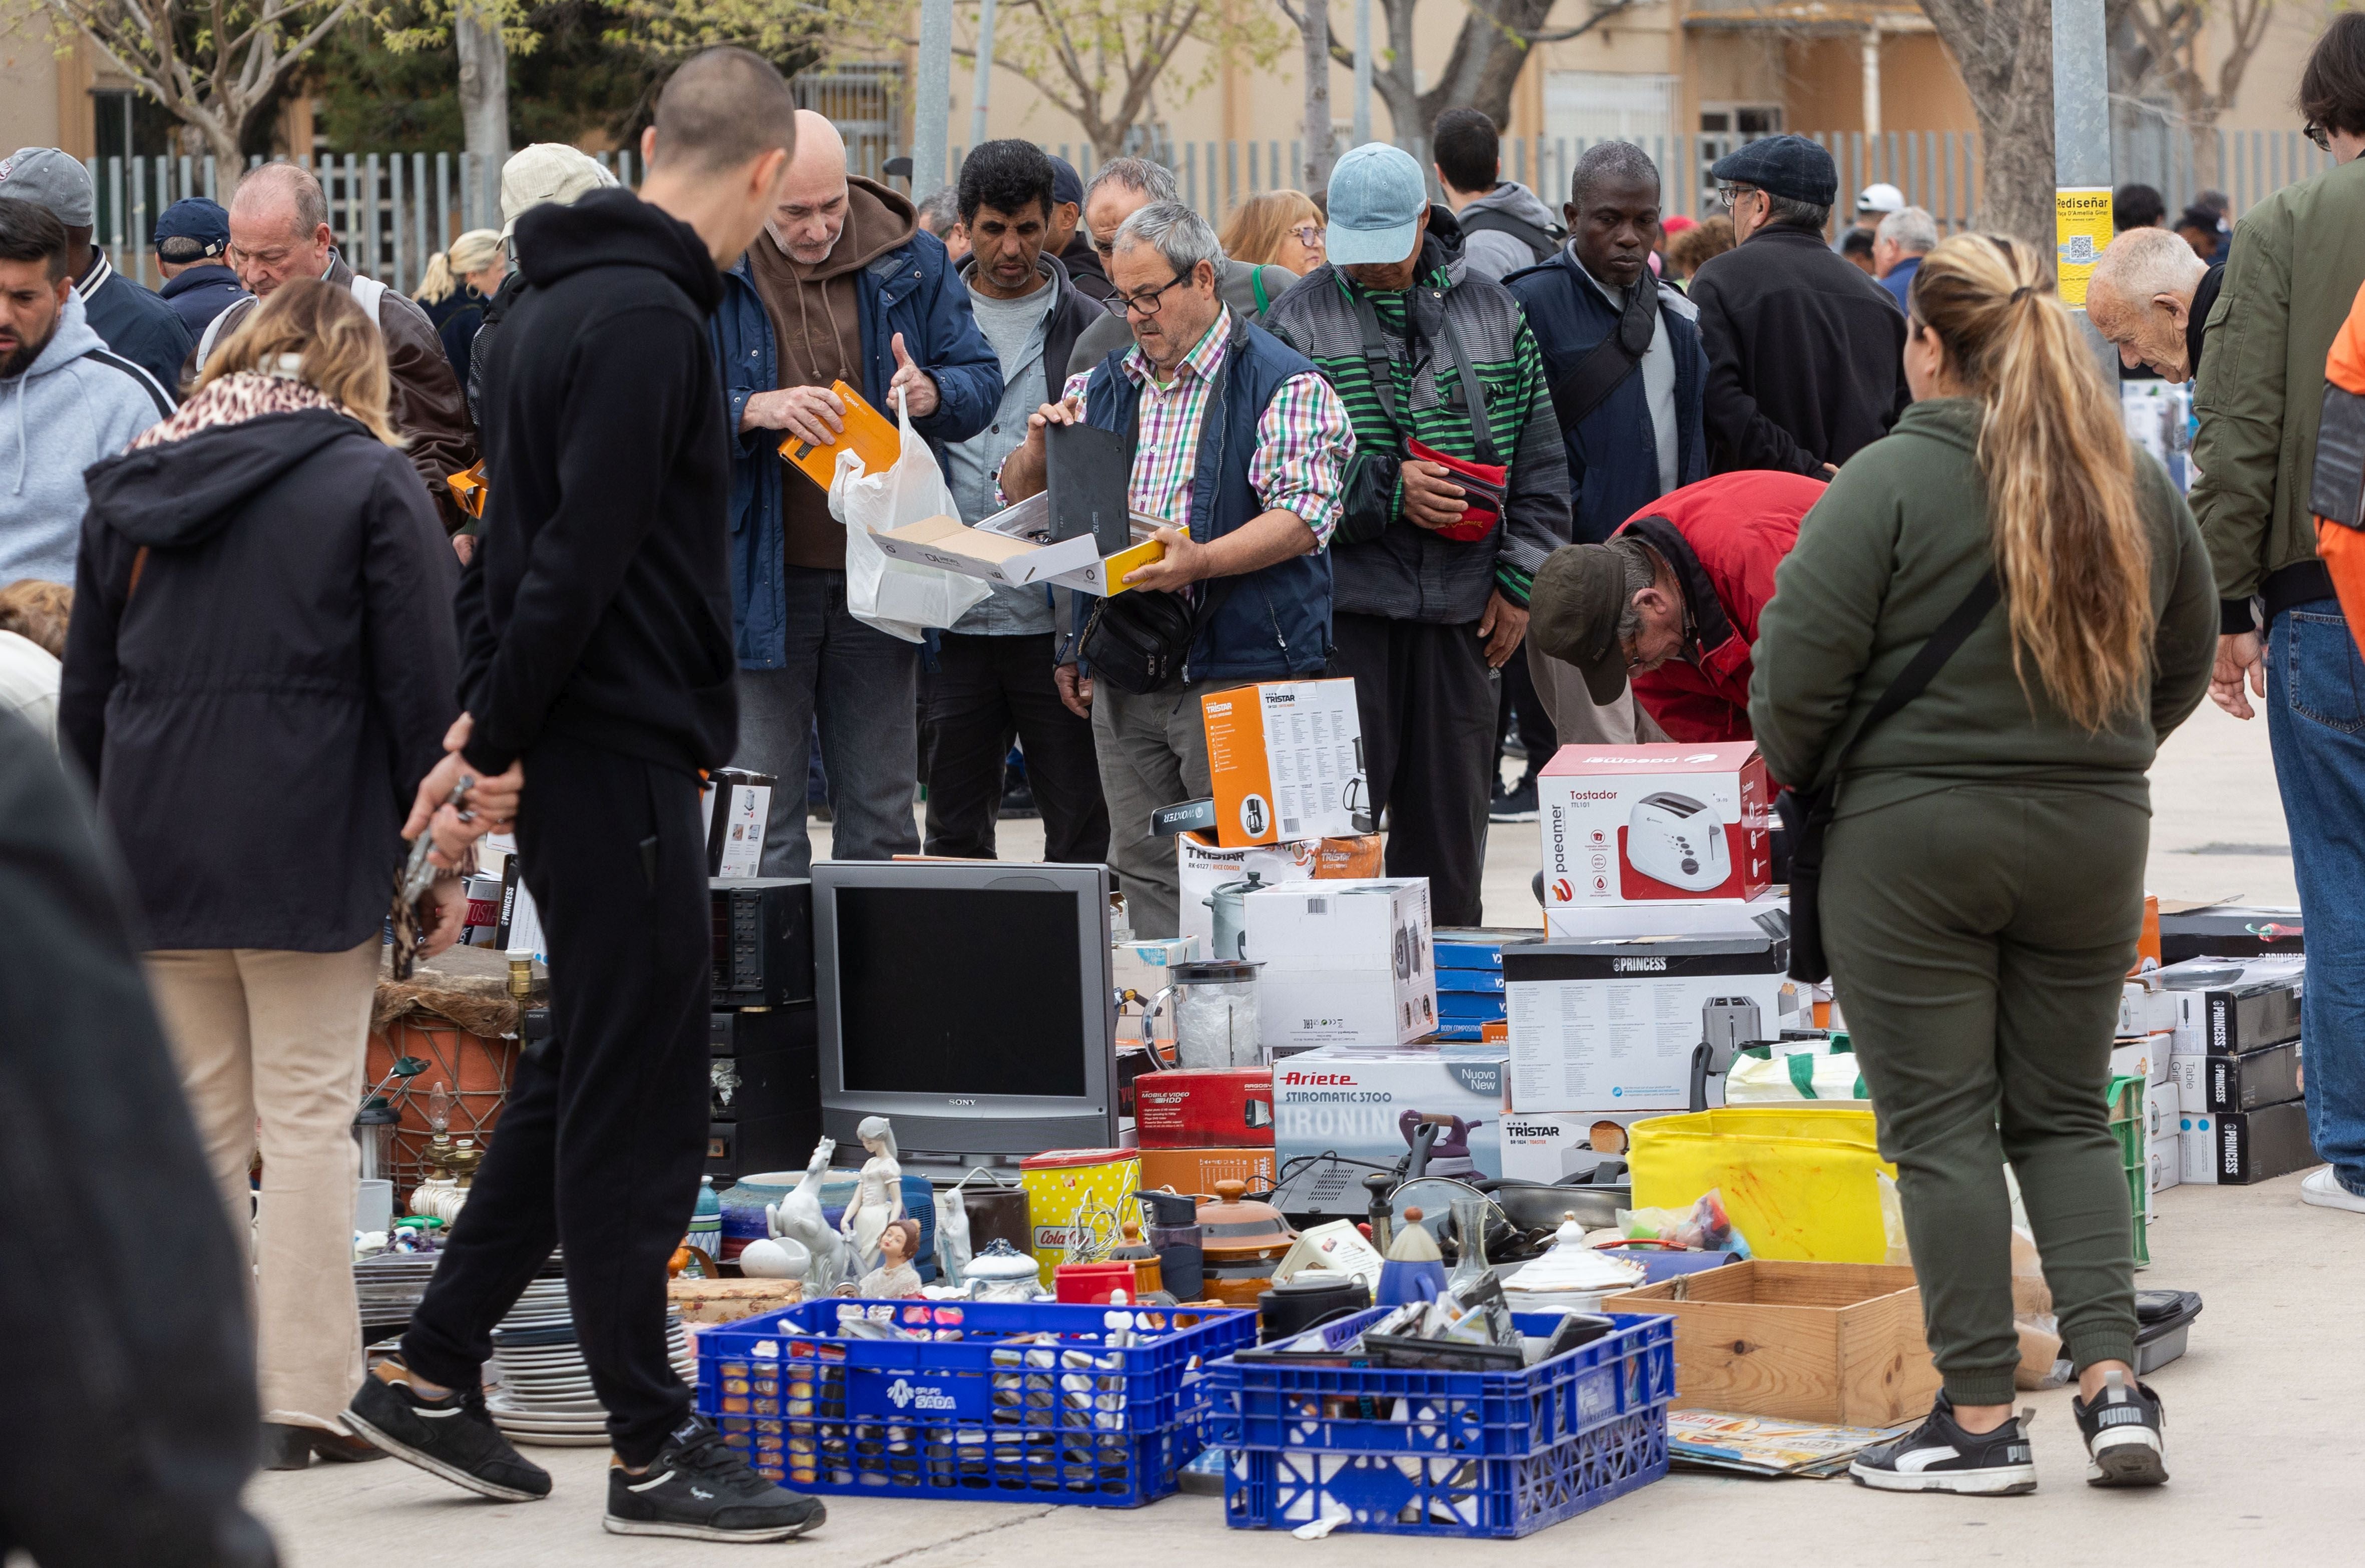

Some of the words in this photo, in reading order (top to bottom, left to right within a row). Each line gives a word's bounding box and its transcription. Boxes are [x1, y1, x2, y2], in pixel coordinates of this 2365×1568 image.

[2057, 197, 2108, 208] Rediseñar
[1266, 694, 1295, 703] TRISTAR
[1206, 702, 1233, 714] TRISTAR
[1570, 790, 1618, 800] Tostador
[1163, 808, 1196, 824] WOXTER
[1551, 805, 1568, 873] paeamer
[502, 887, 514, 920] PRINCESS
[1621, 957, 1667, 972] PRINCESS
[2212, 1006, 2226, 1048] PRINCESS
[1280, 1072, 1358, 1085] Ariete
[1462, 1068, 1496, 1079] Nuovo
[2172, 1062, 2181, 1081] Grill
[2186, 1062, 2195, 1089] Table
[1471, 1079, 1495, 1090] New
[2215, 1069, 2226, 1102] PRINCESS
[1286, 1091, 1357, 1102] STIROMATIC
[1360, 1092, 1392, 1102] 3700
[1506, 1123, 1559, 1136] TRISTAR
[2224, 1129, 2238, 1174] PRINCESS
[1040, 1230, 1066, 1245] Cola
[915, 1395, 957, 1410] SADA
[2098, 1407, 2143, 1427] PUMA
[2007, 1445, 2032, 1463] PU
